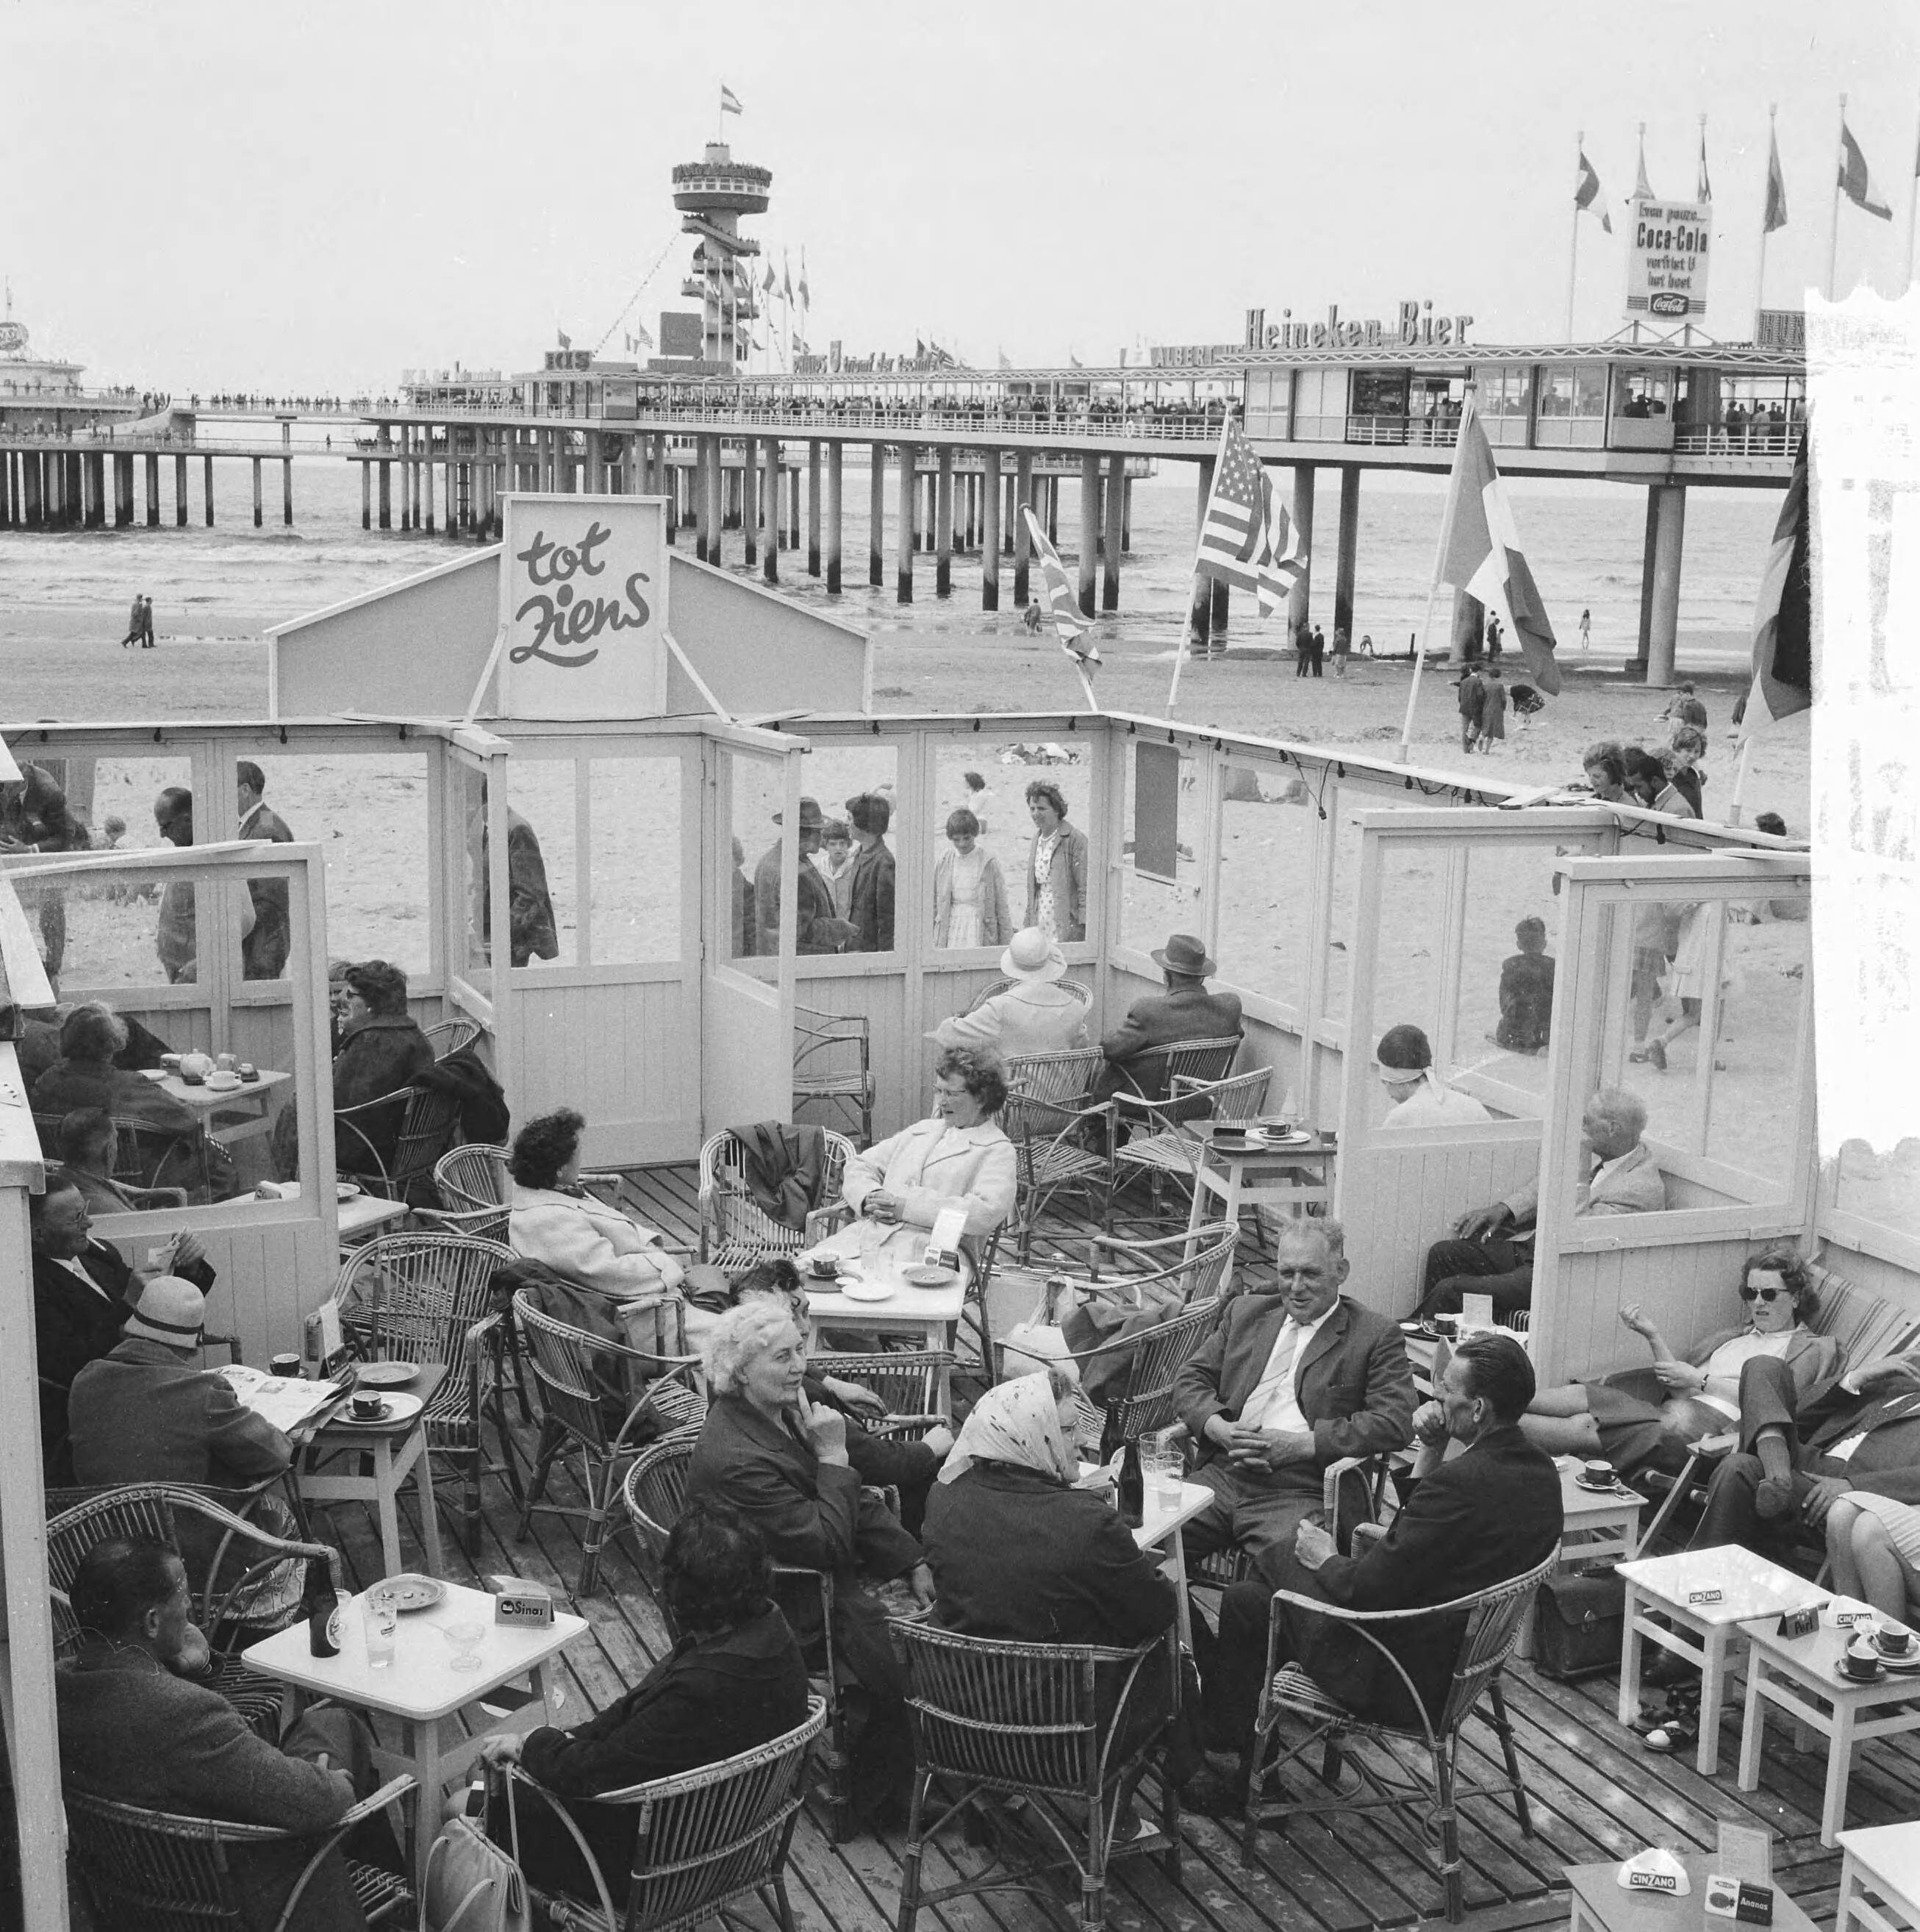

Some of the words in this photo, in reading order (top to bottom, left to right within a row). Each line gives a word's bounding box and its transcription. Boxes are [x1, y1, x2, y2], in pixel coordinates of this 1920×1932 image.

[1637, 222, 1708, 253] Coca-Cola
[1688, 257, 1696, 271] U
[1244, 304, 1382, 350] Heineken
[1398, 299, 1474, 346] Bier
[517, 522, 612, 586] tot
[1691, 1592, 1720, 1601] CINZANO
[1632, 1875, 1674, 1887] CINZANO
[1740, 1897, 1768, 1910] Ananas
